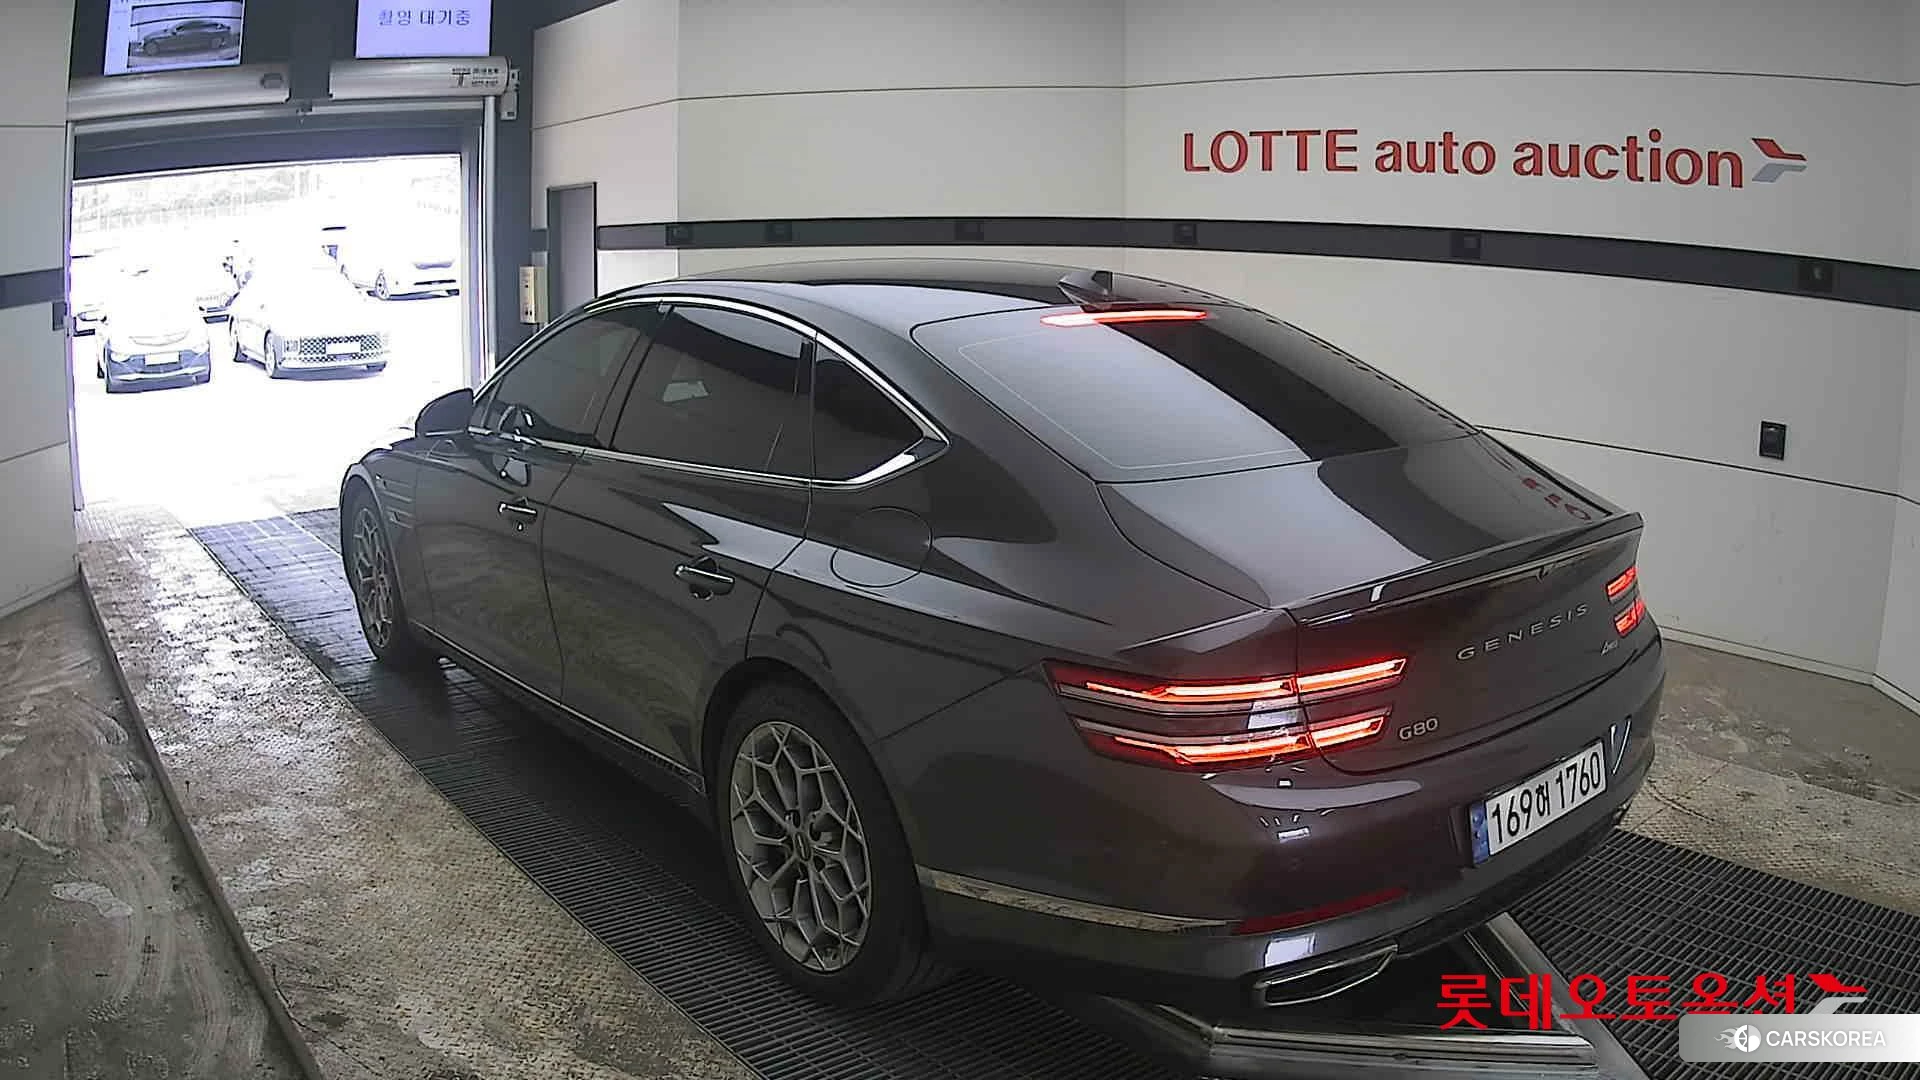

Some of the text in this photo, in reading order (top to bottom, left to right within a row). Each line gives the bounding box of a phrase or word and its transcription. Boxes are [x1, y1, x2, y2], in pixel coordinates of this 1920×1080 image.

[419, 8, 472, 26] 대기중
[1184, 128, 1743, 188] LOTTE auto auction
[1456, 603, 1589, 660] GENESIS
[1399, 717, 1439, 741] G80
[1492, 751, 1601, 844] 169허 1760
